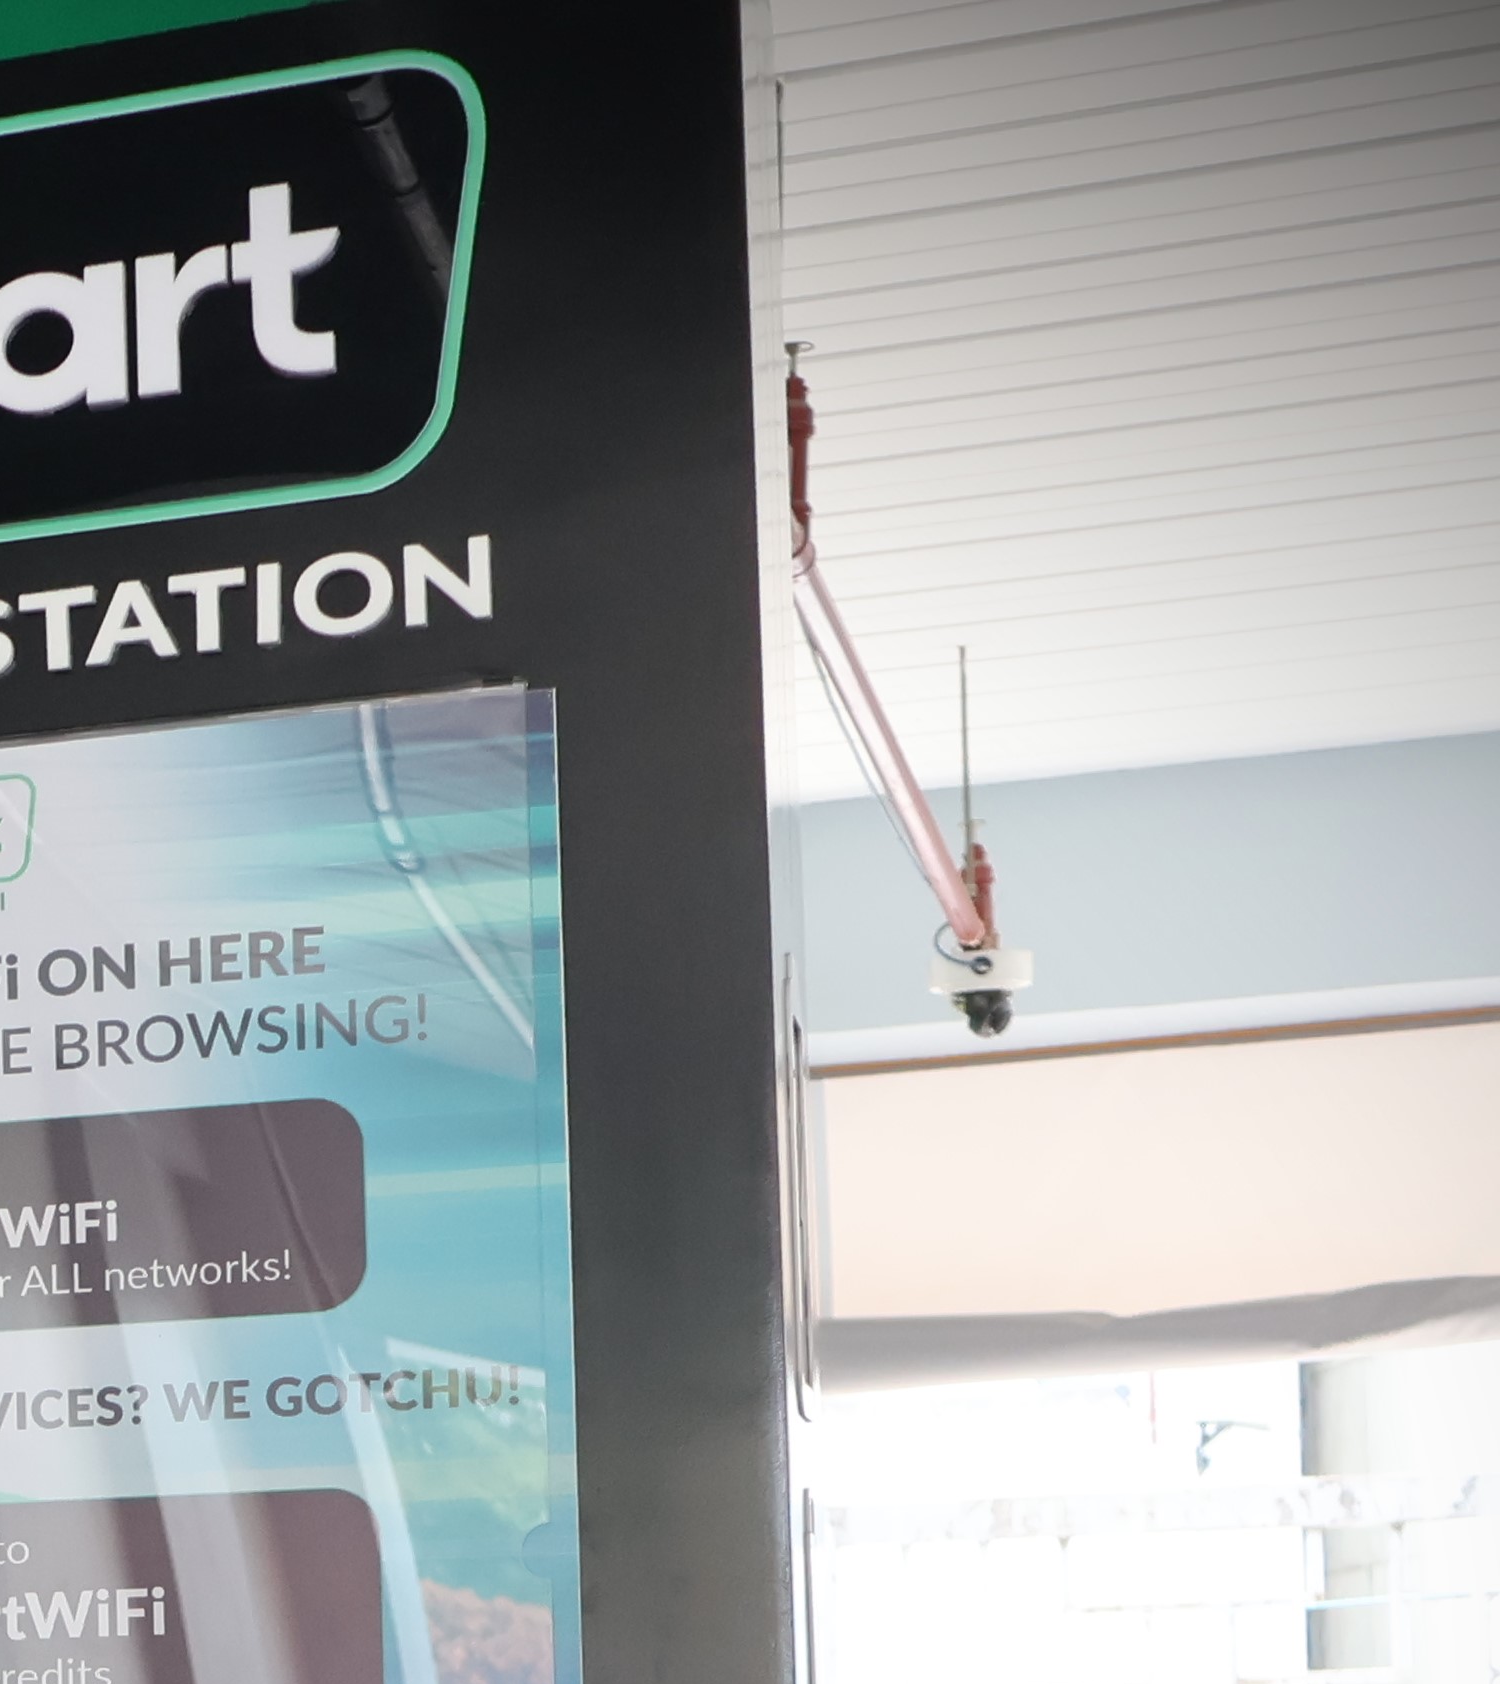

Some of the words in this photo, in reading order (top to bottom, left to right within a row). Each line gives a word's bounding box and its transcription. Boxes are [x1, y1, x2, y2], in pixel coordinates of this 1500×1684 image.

[38, 943, 136, 996] ON
[159, 925, 326, 987] HERE
[55, 993, 428, 1070] BROWSING!
[0, 1200, 119, 1248] WiFi
[20, 1263, 92, 1298] ALL
[104, 1249, 292, 1293] networks!
[163, 1380, 251, 1423] WE
[265, 1366, 520, 1419] GOTCHU!
